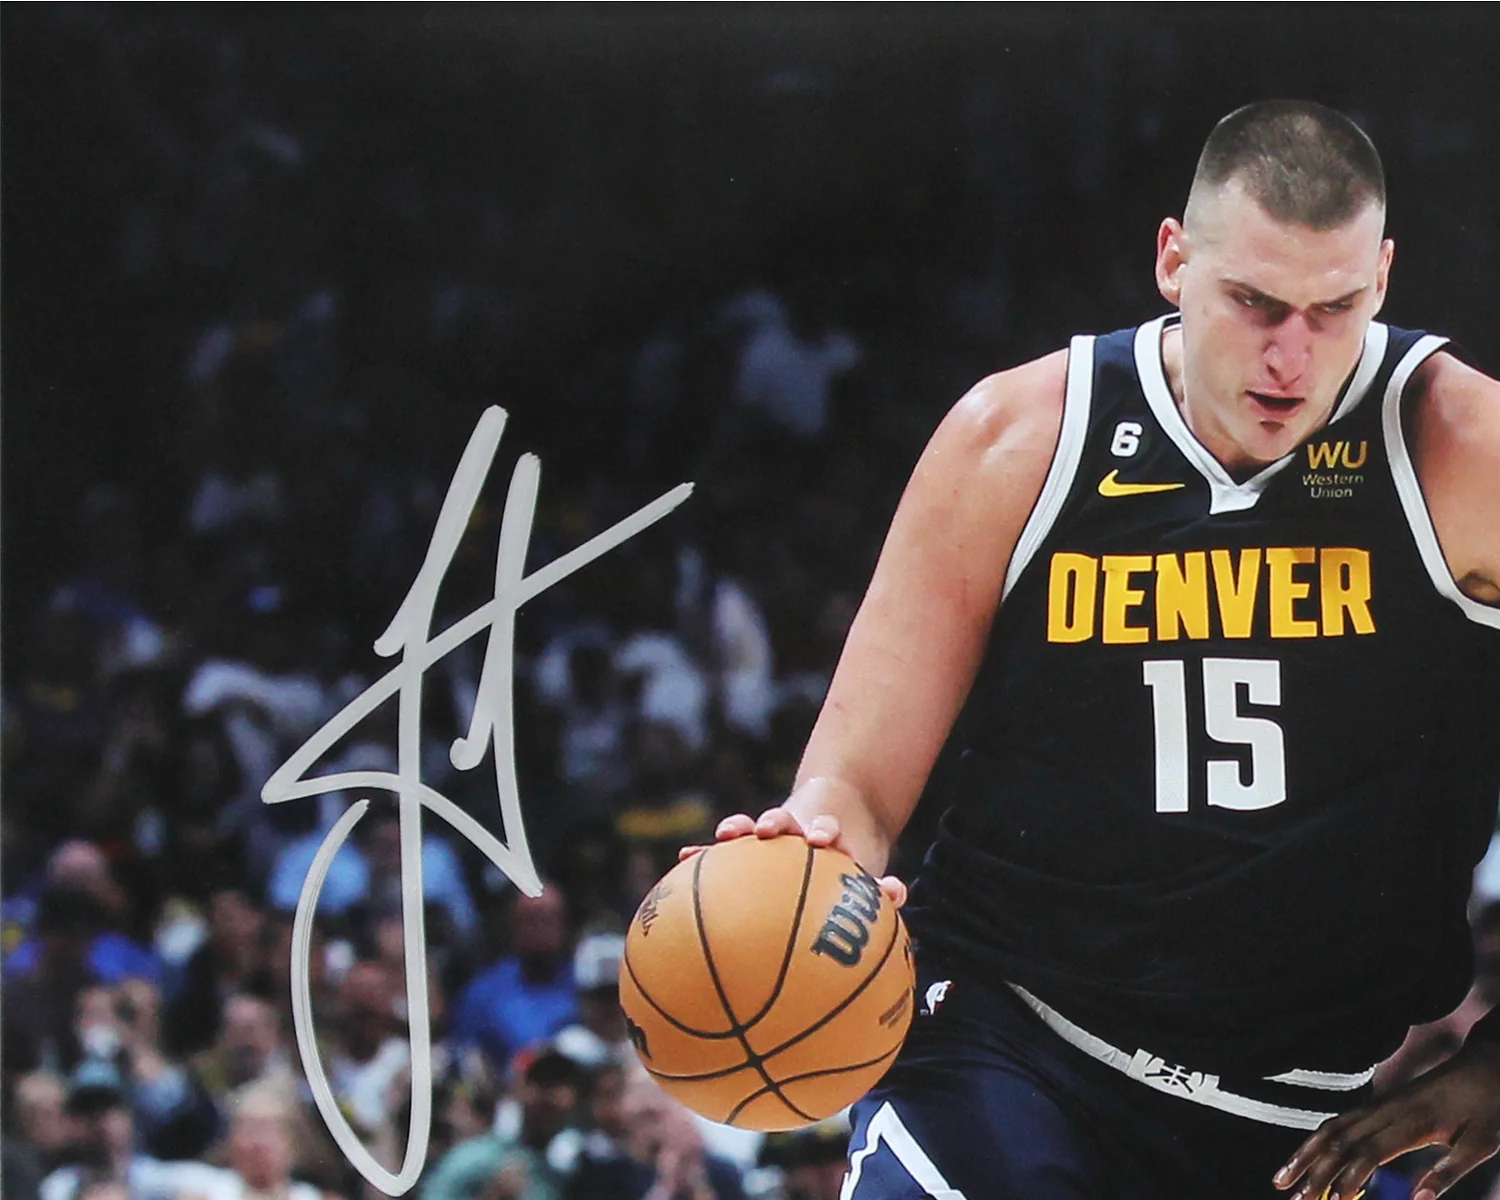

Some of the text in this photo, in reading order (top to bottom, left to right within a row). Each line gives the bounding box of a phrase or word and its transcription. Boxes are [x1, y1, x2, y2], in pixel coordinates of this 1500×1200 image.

[1110, 422, 1142, 457] 6
[1307, 441, 1368, 469] WU
[1302, 474, 1364, 486] Western
[1310, 487, 1353, 498] Union
[1047, 547, 1376, 643] DENVER
[1143, 657, 1286, 813] 15
